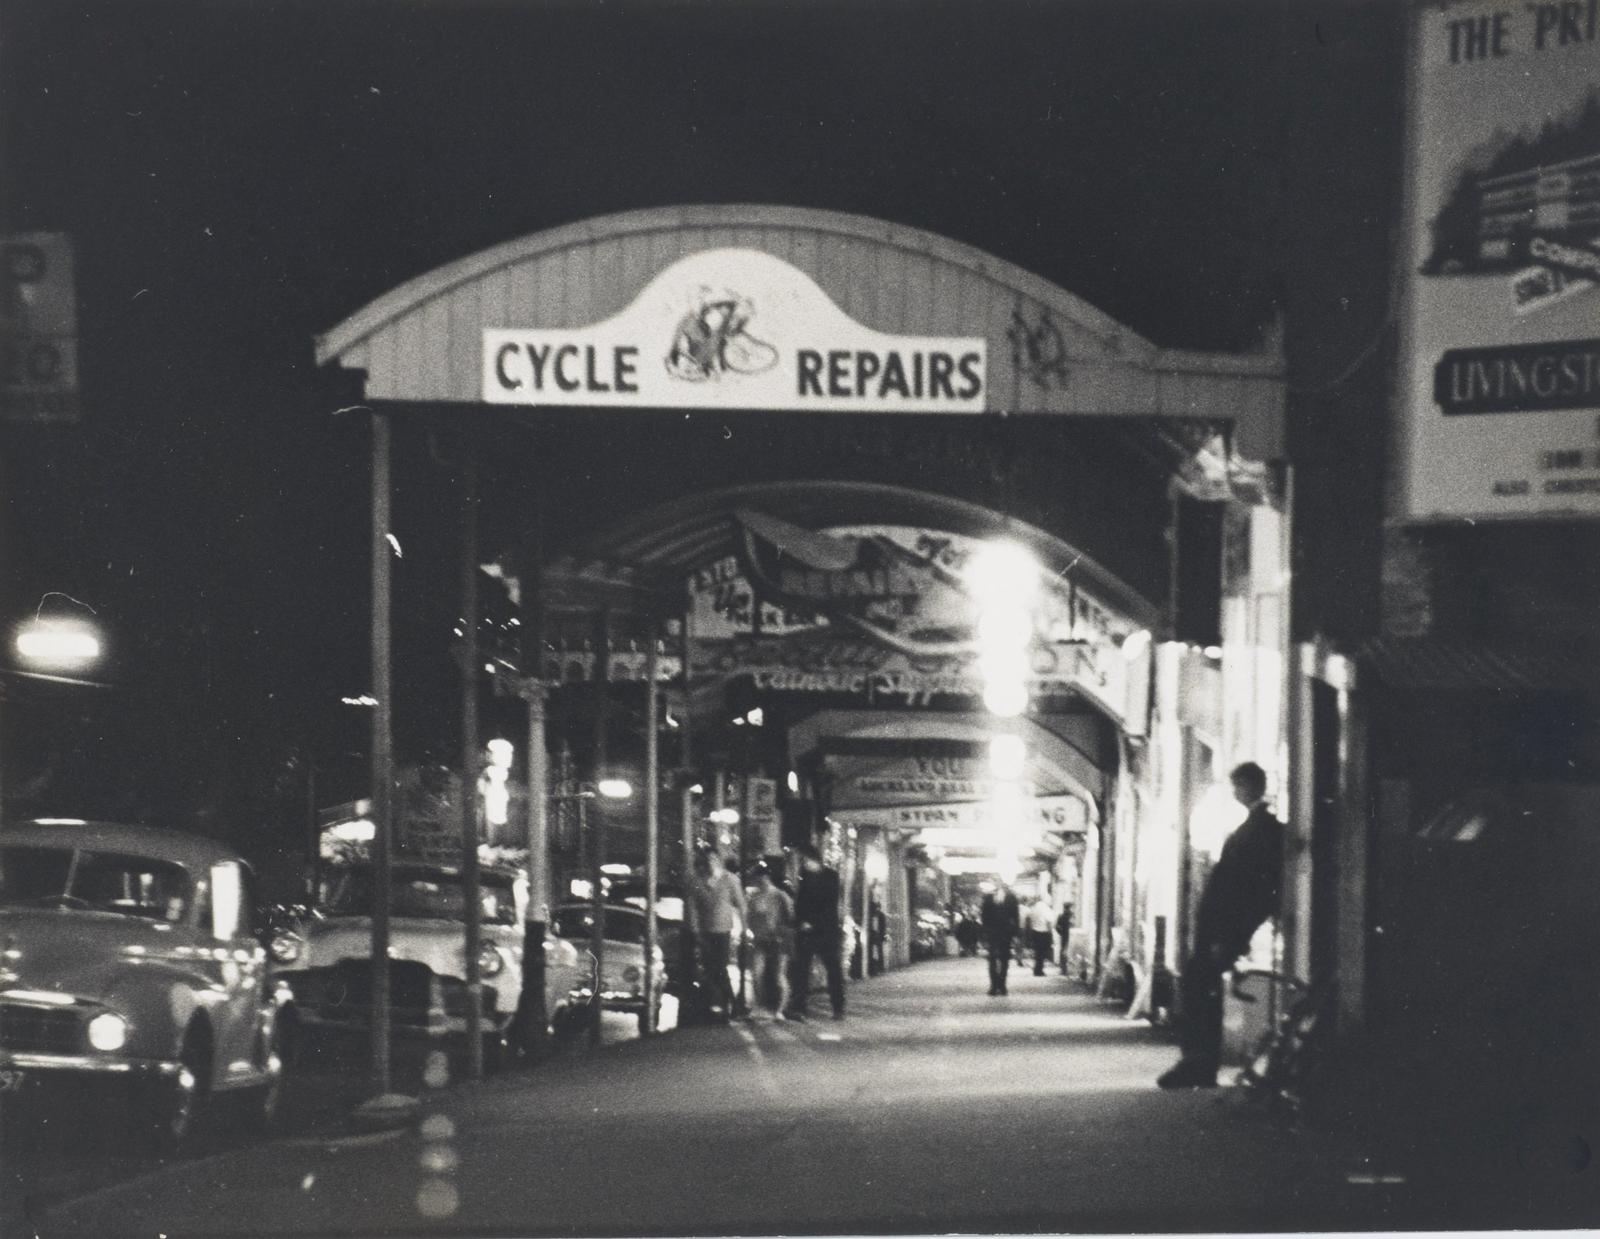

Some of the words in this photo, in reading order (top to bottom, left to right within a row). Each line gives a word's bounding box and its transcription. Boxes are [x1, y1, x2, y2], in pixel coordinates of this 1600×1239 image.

[1447, 12, 1510, 63] THE
[496, 342, 639, 393] CYCLE
[798, 348, 983, 401] REPAIRS
[1451, 352, 1600, 402] LIVINGST
